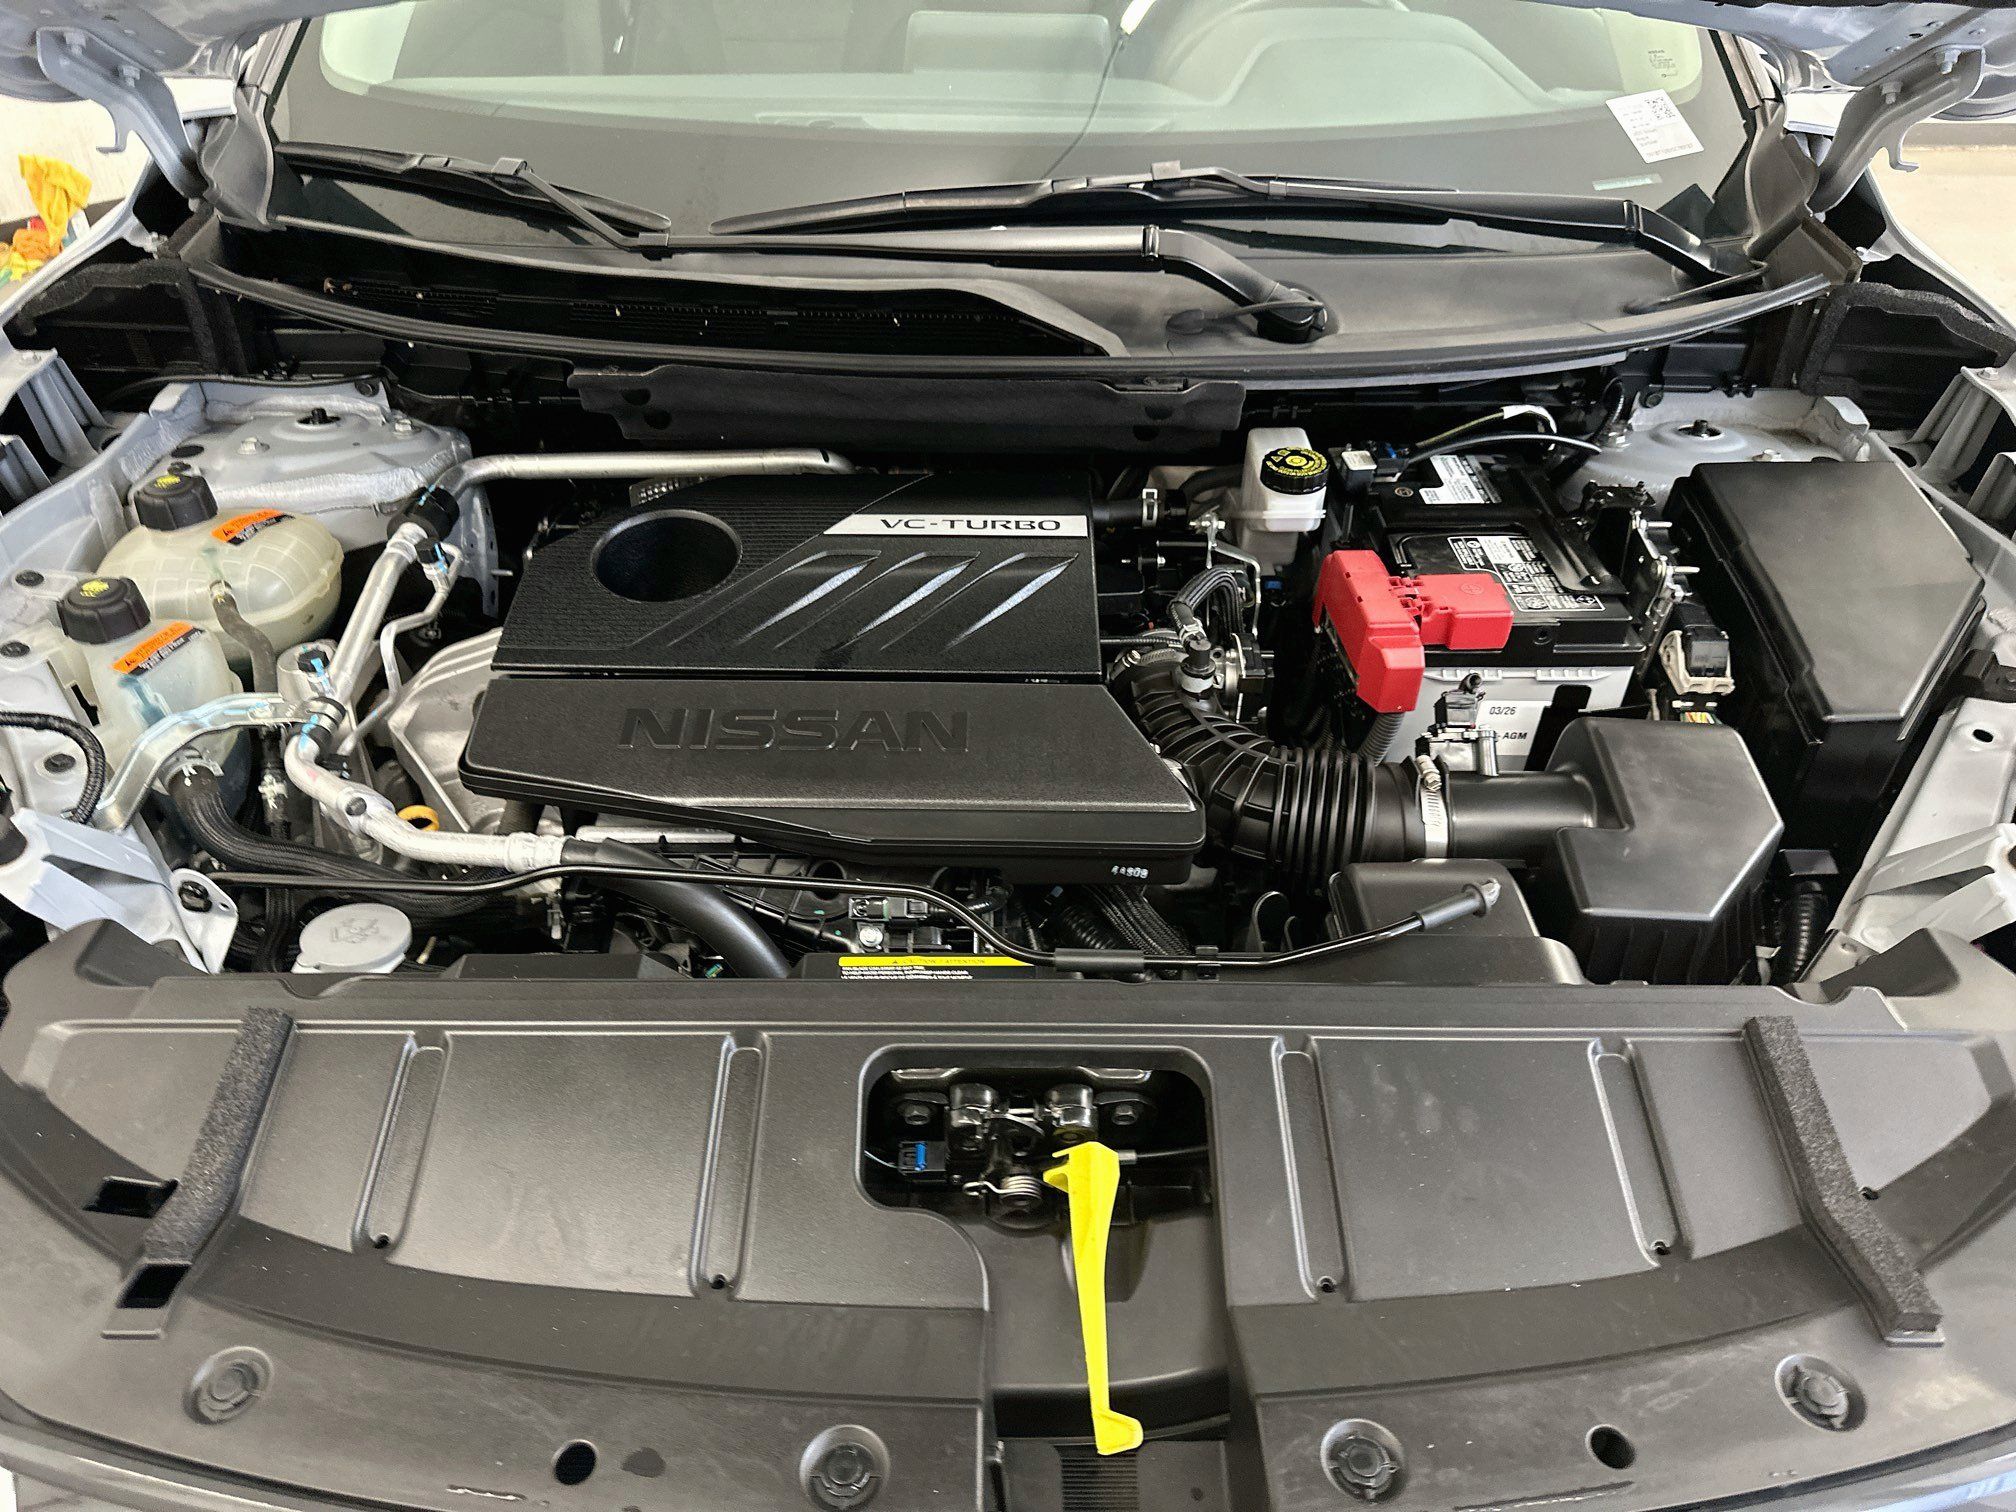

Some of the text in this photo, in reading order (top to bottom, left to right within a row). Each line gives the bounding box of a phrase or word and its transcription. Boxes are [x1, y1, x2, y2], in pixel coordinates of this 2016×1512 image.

[881, 519, 1061, 531] VC-TURBO
[1489, 706, 1517, 715] 03/26
[618, 709, 969, 752] NISSAN
[1502, 732, 1528, 740] AGM
